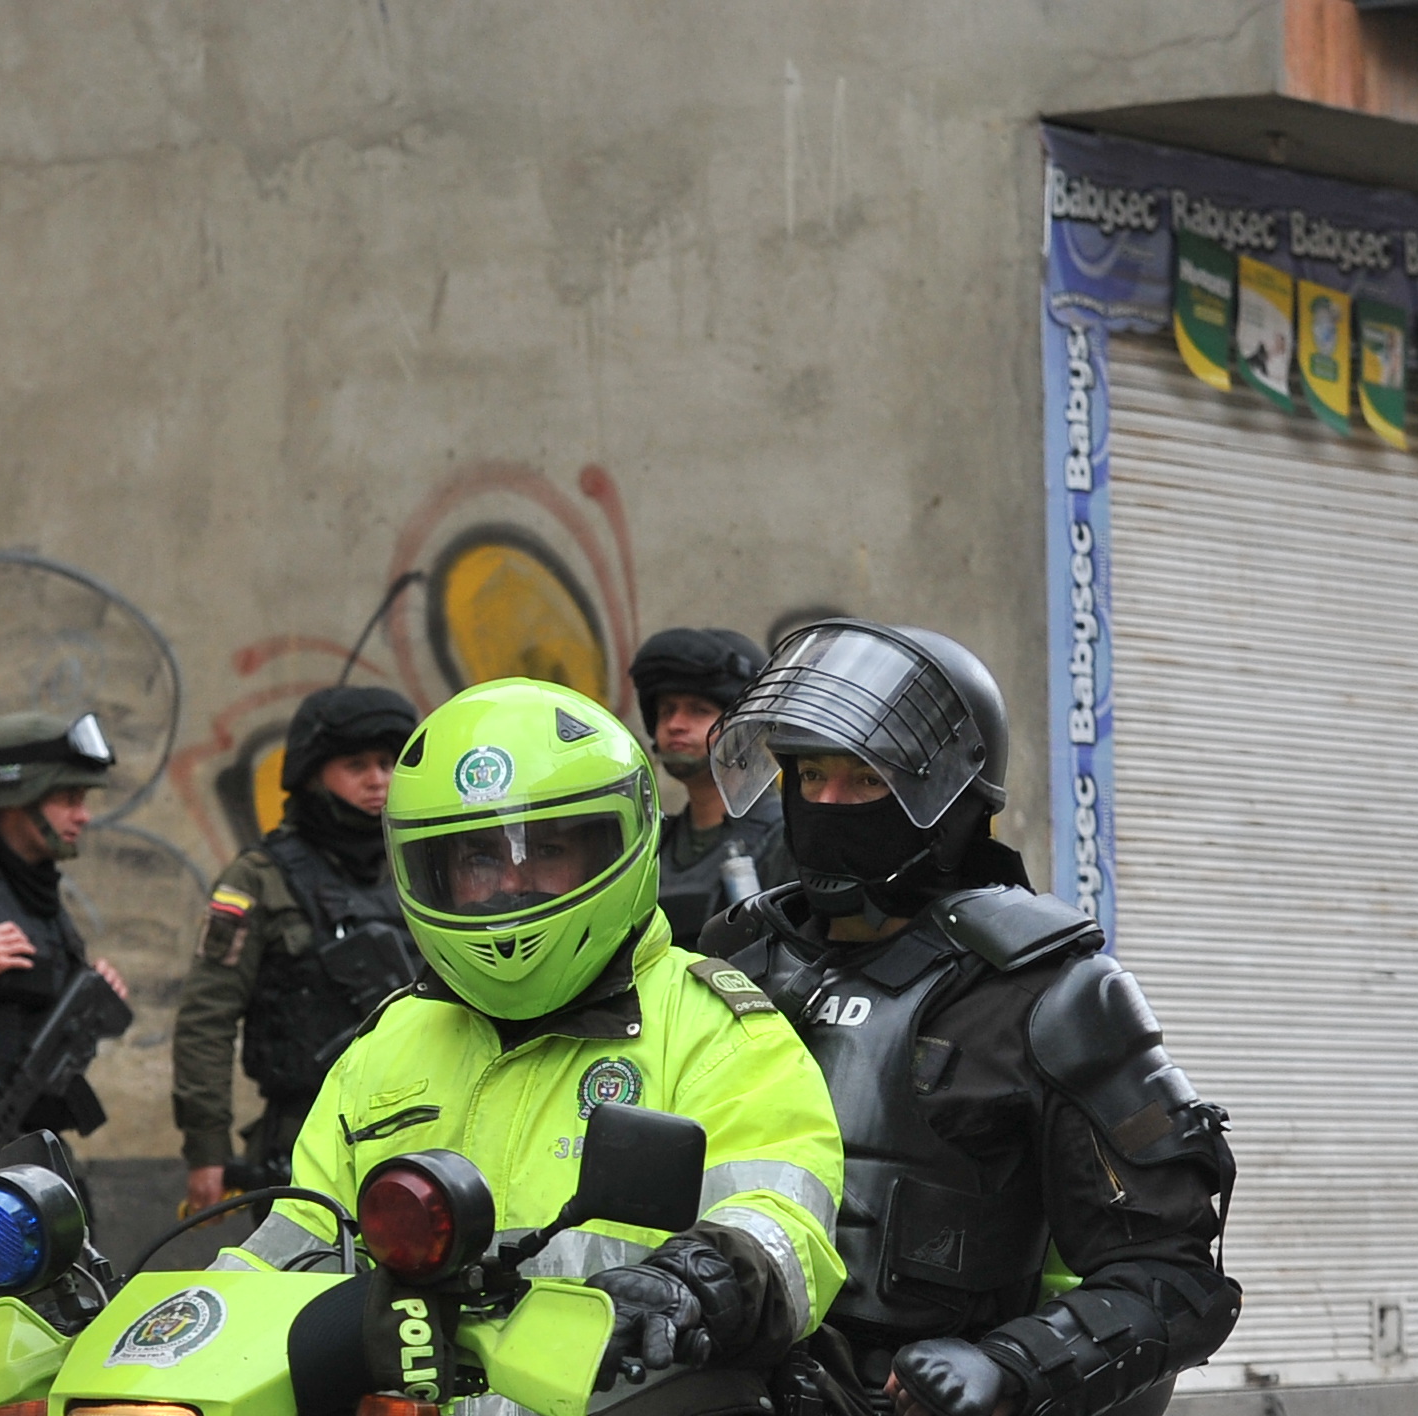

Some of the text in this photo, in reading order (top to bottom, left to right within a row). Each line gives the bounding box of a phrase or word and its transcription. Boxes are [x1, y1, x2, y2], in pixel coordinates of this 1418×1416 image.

[1052, 168, 1158, 234] Babysec
[1290, 210, 1395, 270] Babysec
[1068, 521, 1100, 746] Babysec
